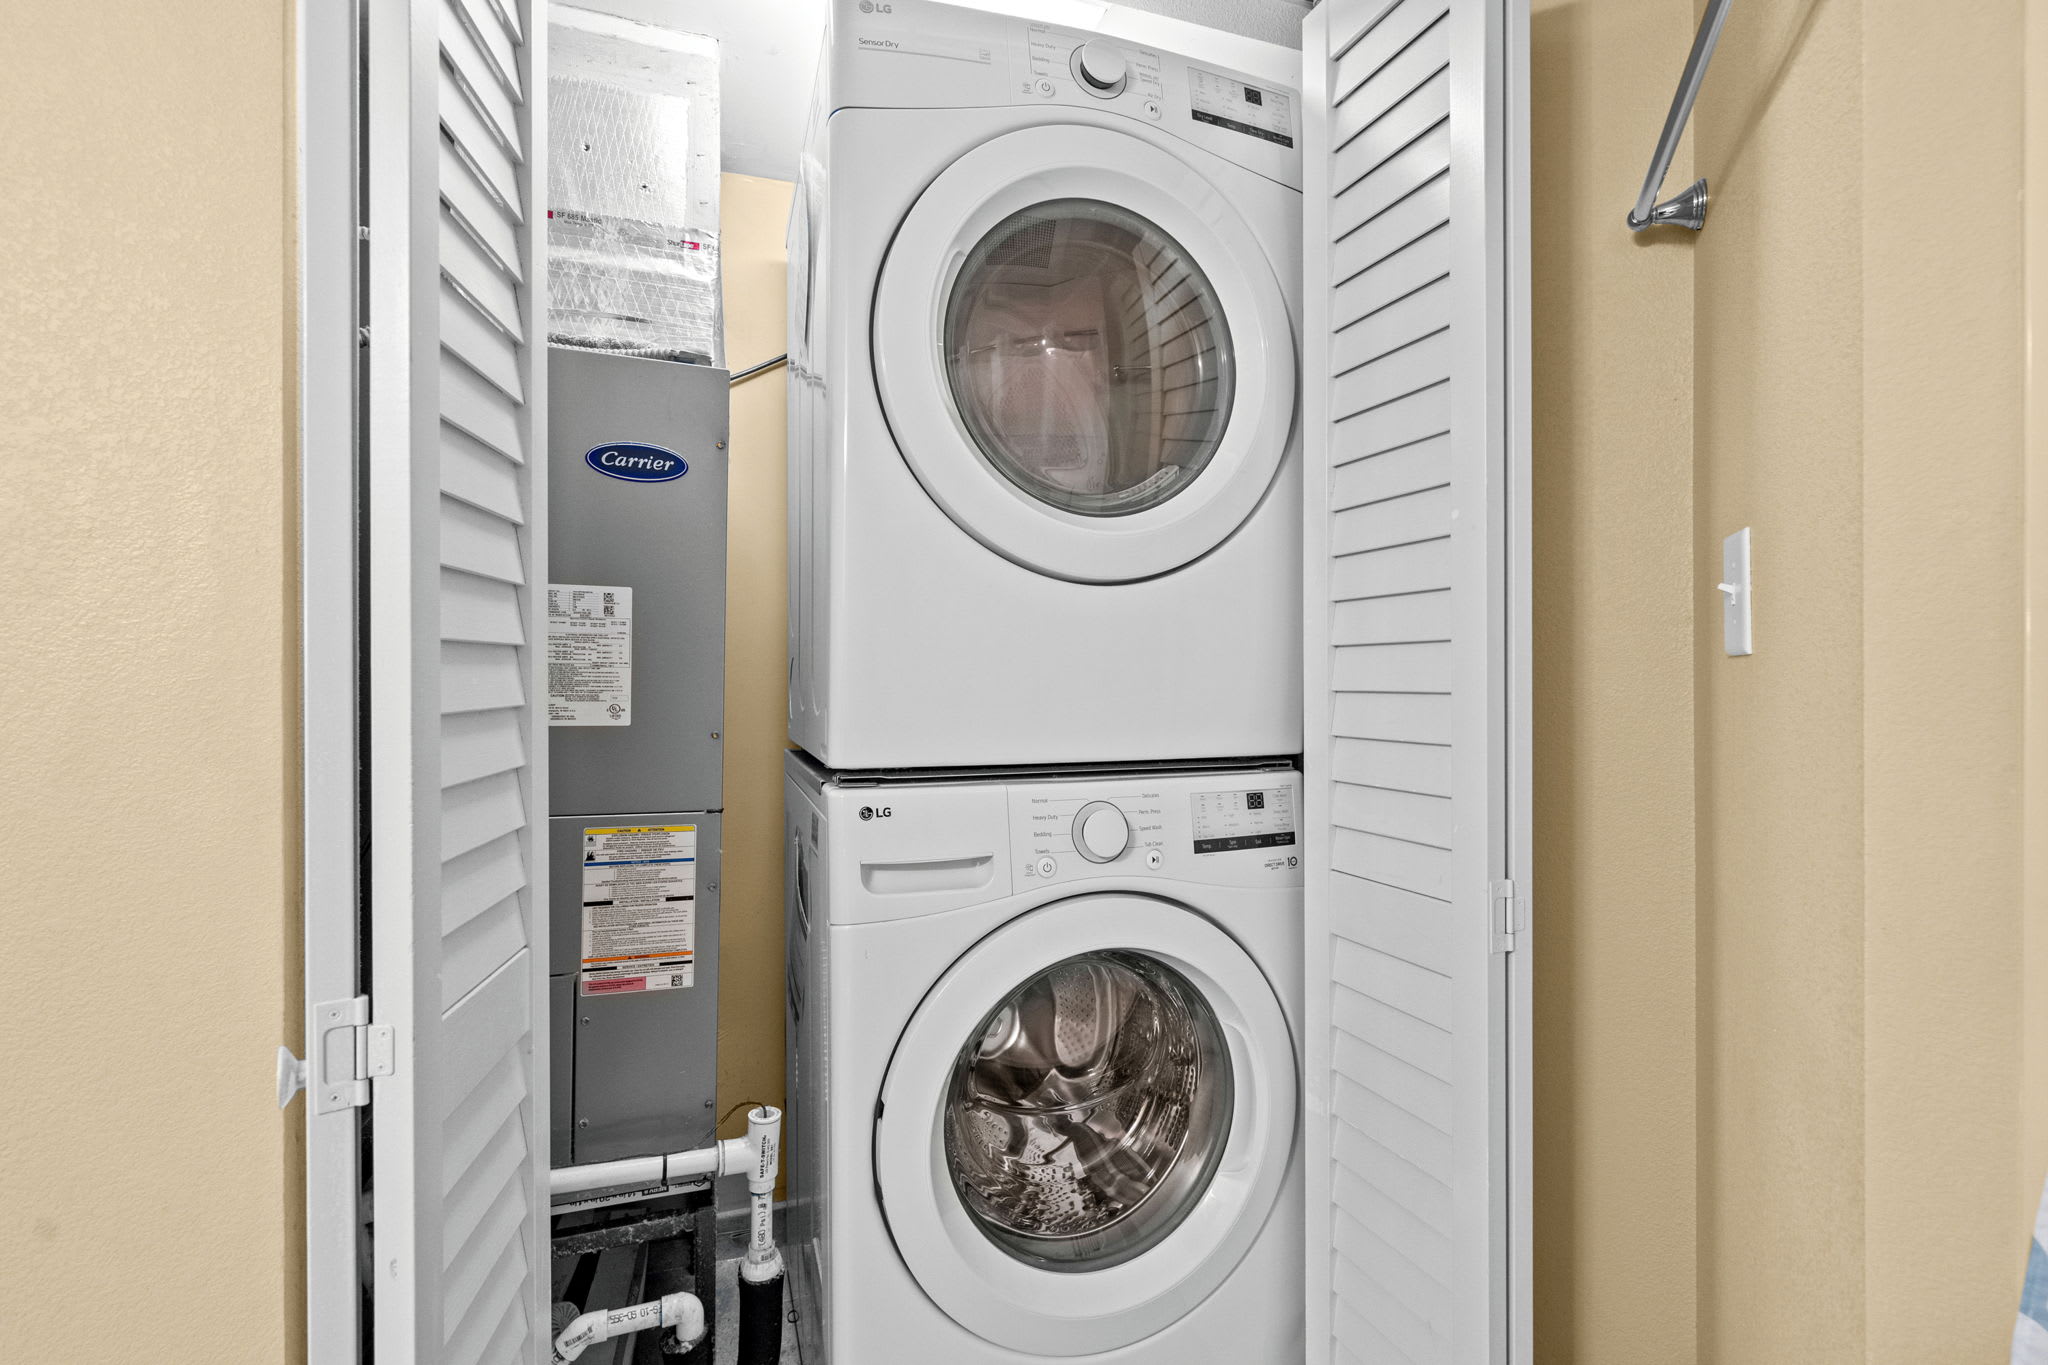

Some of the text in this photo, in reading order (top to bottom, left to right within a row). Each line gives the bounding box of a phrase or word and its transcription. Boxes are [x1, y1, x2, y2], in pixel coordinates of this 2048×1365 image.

[876, 4, 892, 14] LG
[601, 451, 674, 471] Carrier
[875, 807, 892, 818] LG
